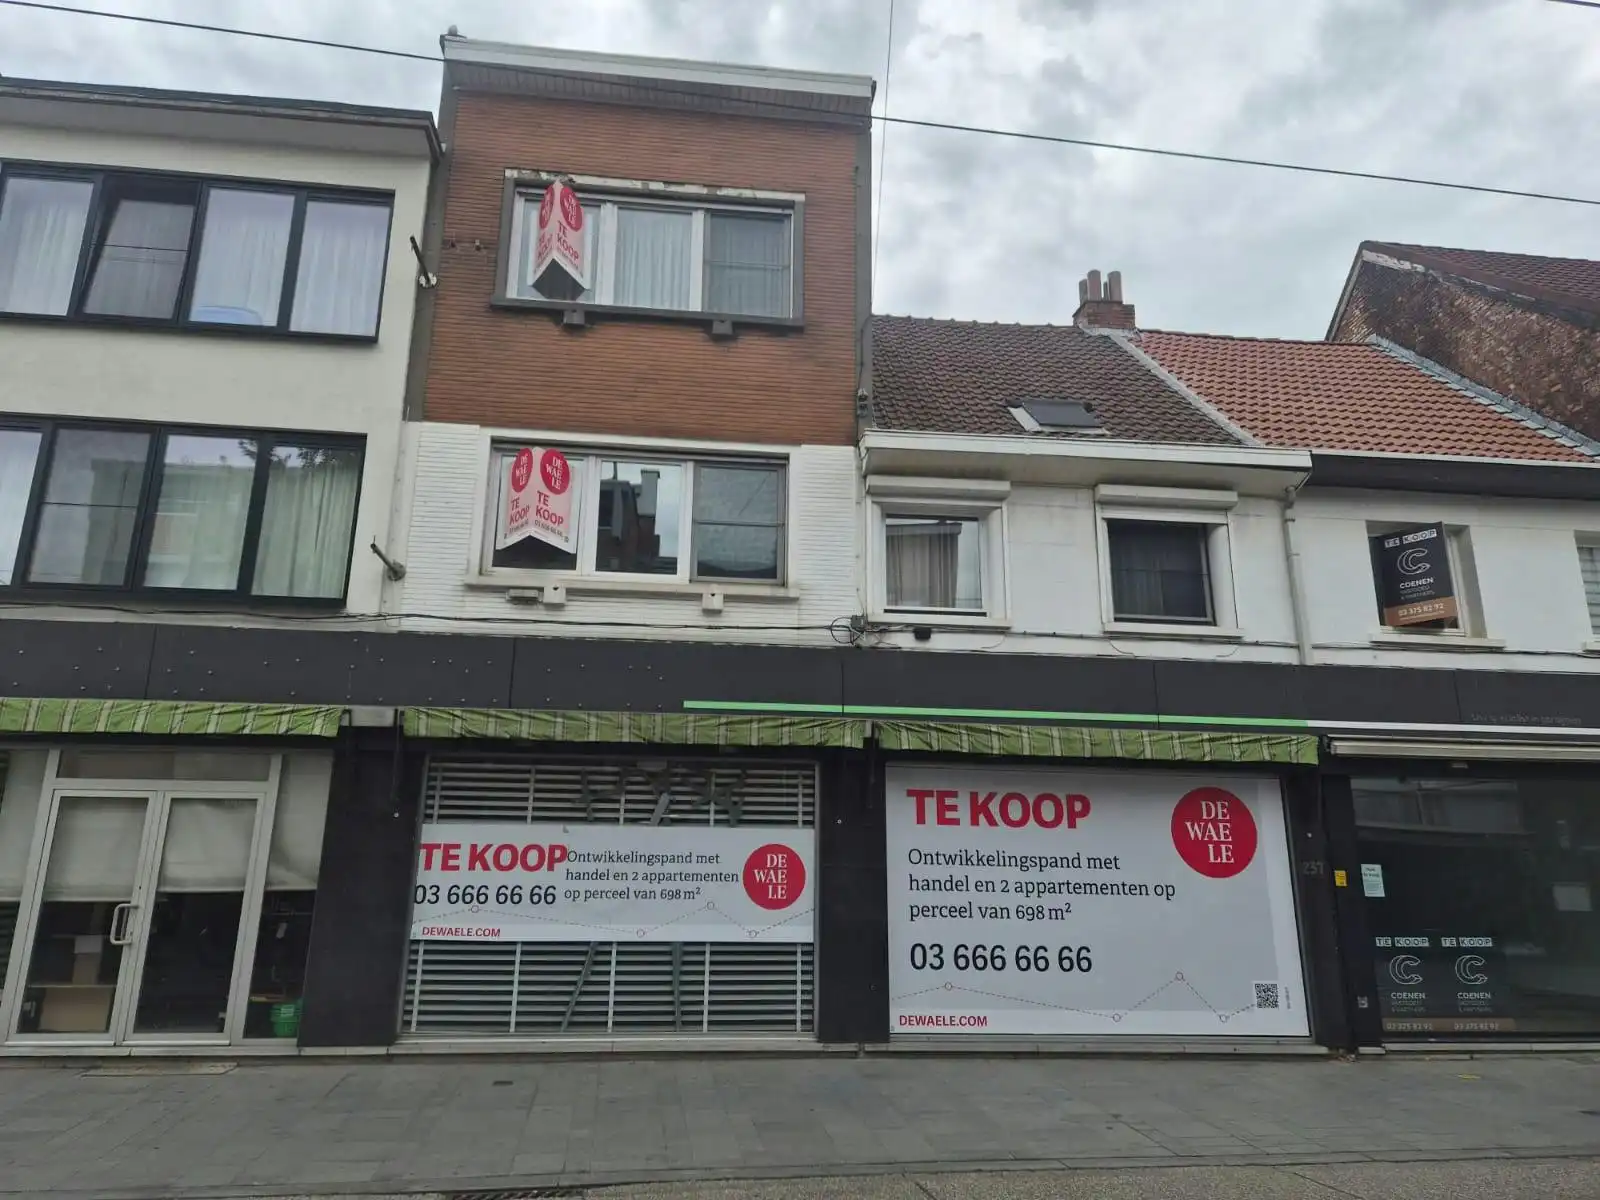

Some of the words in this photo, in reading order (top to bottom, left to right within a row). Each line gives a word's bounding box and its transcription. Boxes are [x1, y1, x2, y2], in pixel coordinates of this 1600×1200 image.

[557, 220, 568, 238] TE
[557, 233, 579, 261] KOOP
[546, 463, 563, 480] WAE
[553, 456, 563, 470] DE
[552, 477, 562, 490] LE
[511, 497, 520, 511] TE
[537, 490, 549, 507] TE
[510, 504, 530, 526] KOOP
[535, 505, 564, 527] KOOP
[1402, 529, 1437, 544] KOOP
[1400, 577, 1434, 589] COENEN
[907, 788, 961, 826] TE
[969, 792, 1092, 830] KOOP
[1201, 800, 1231, 820] DE
[1184, 821, 1233, 842] WAE
[421, 842, 462, 872] TE
[468, 843, 568, 872] KOOP
[566, 850, 693, 866] Ontwikkelingspand
[695, 853, 721, 865] met
[766, 853, 788, 868] DE
[907, 848, 1083, 873] Ontwikkelingspand
[1086, 853, 1121, 870] met
[1208, 843, 1235, 863] LE
[565, 867, 610, 881] handel
[612, 870, 629, 881] en
[631, 871, 640, 881] 2
[641, 870, 740, 886] appartementen
[753, 869, 788, 884] WAE
[415, 884, 441, 905] 03
[447, 884, 490, 905] 666
[495, 884, 524, 905] 66
[529, 884, 557, 906] 66
[563, 889, 581, 903] op
[583, 886, 631, 903] perceel
[633, 889, 657, 900] van
[659, 888, 683, 901] 698
[767, 885, 787, 900] LE
[908, 873, 970, 894] handel
[973, 878, 997, 894] en
[1000, 879, 1010, 894] 2
[1014, 877, 1150, 900] appartementen
[1153, 884, 1176, 902] op
[908, 901, 975, 922] perceel
[977, 905, 1011, 921] van
[1015, 904, 1046, 922] 698
[421, 926, 501, 937] DEWAELE.COM
[1376, 937, 1392, 947] TE
[1395, 937, 1429, 947] KOOP
[1441, 937, 1457, 947] TE
[1459, 937, 1493, 947] KOOP
[910, 942, 945, 971] 03
[952, 943, 1007, 972] 666
[1014, 944, 1051, 973] 66
[1057, 945, 1094, 973] 66
[899, 1015, 988, 1027] DEWAELE.COM
